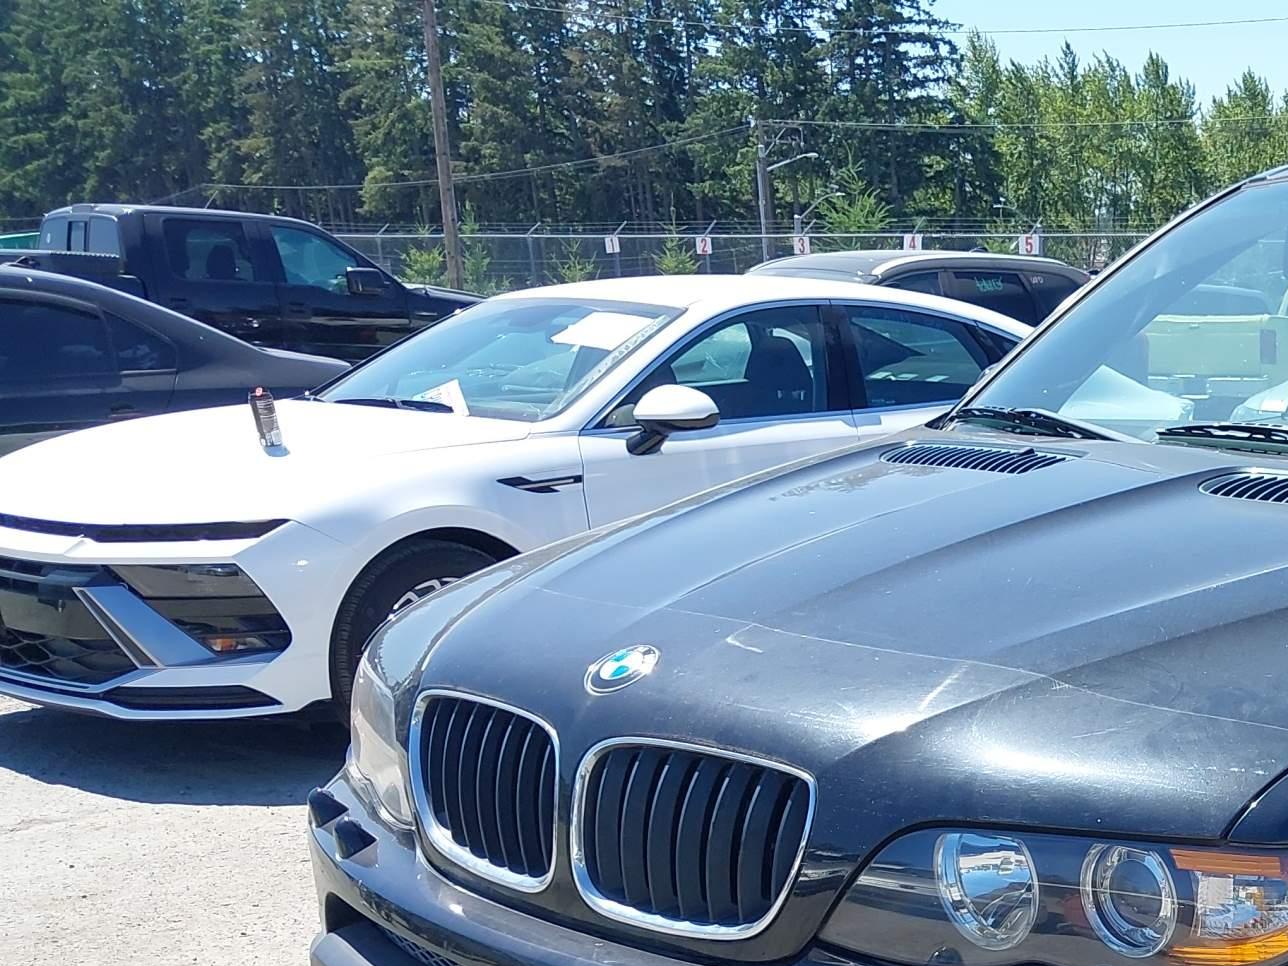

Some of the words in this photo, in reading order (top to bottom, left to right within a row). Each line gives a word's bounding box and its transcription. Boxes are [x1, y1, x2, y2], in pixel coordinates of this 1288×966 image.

[700, 238, 708, 253] 2
[798, 238, 806, 254] 3
[908, 237, 917, 250] 4
[1024, 238, 1034, 253] 5
